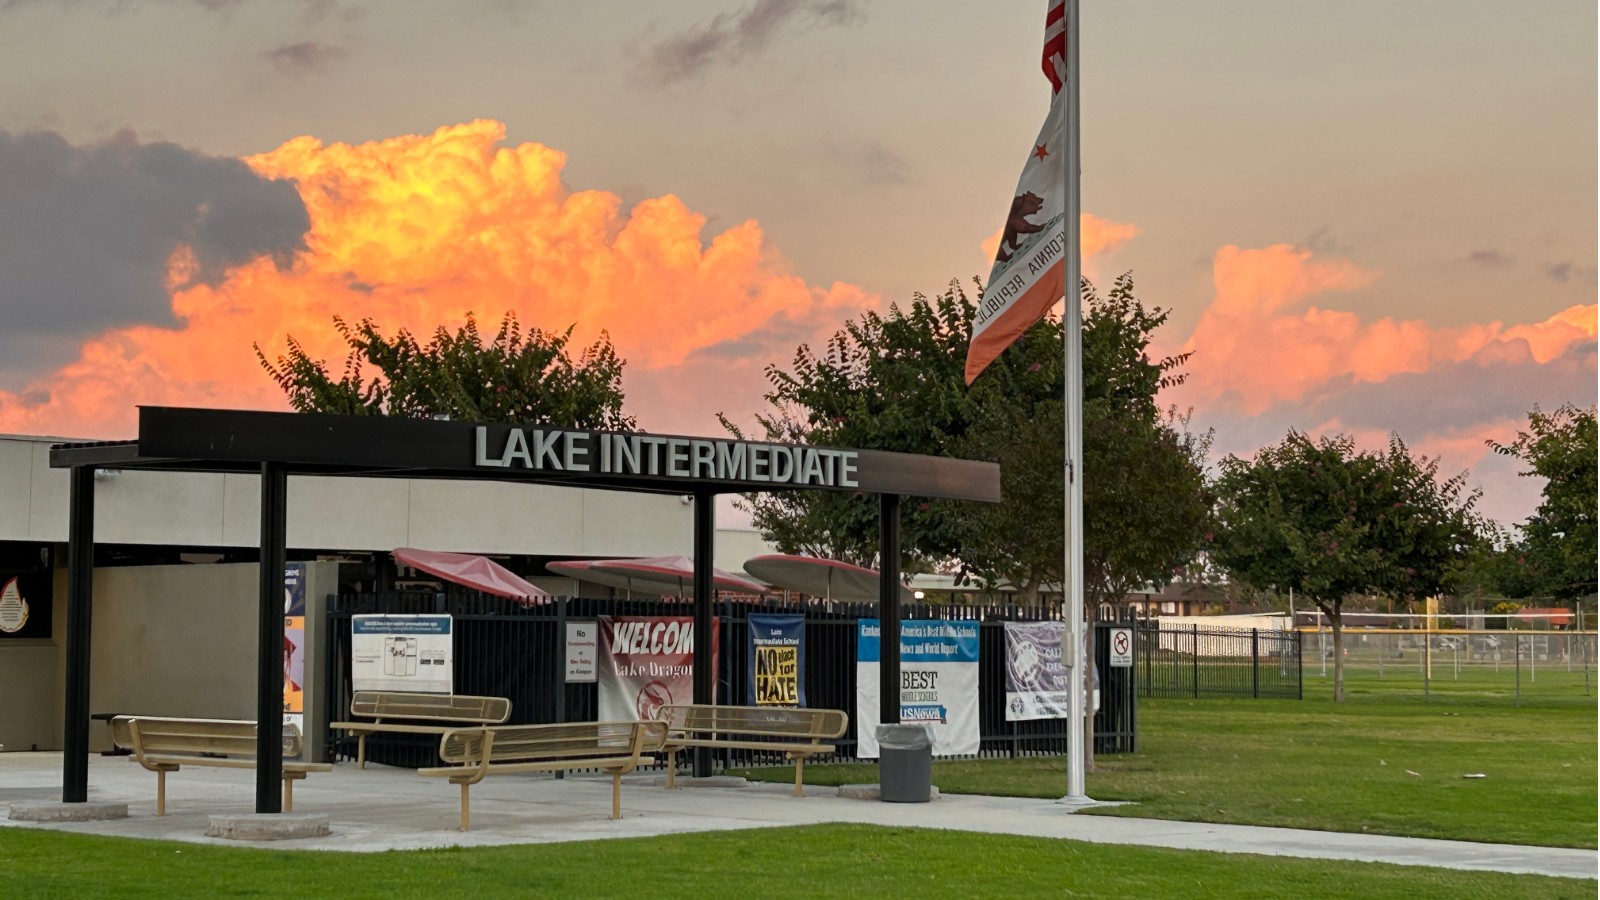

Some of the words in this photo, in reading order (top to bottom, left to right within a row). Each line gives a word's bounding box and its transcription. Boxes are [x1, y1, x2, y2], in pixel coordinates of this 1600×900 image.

[475, 425, 590, 472] LAKE
[600, 433, 859, 488] INTERMEDIATE
[612, 621, 694, 655] WELCOM
[900, 625, 926, 638] America's
[956, 625, 977, 638] Schools
[914, 642, 925, 654] and
[924, 642, 940, 655] World
[940, 642, 959, 657] Report
[614, 661, 645, 677] Lake
[650, 661, 693, 679] Drago
[757, 648, 778, 677] NO
[756, 676, 797, 702] HATE
[902, 671, 938, 689] BEST
